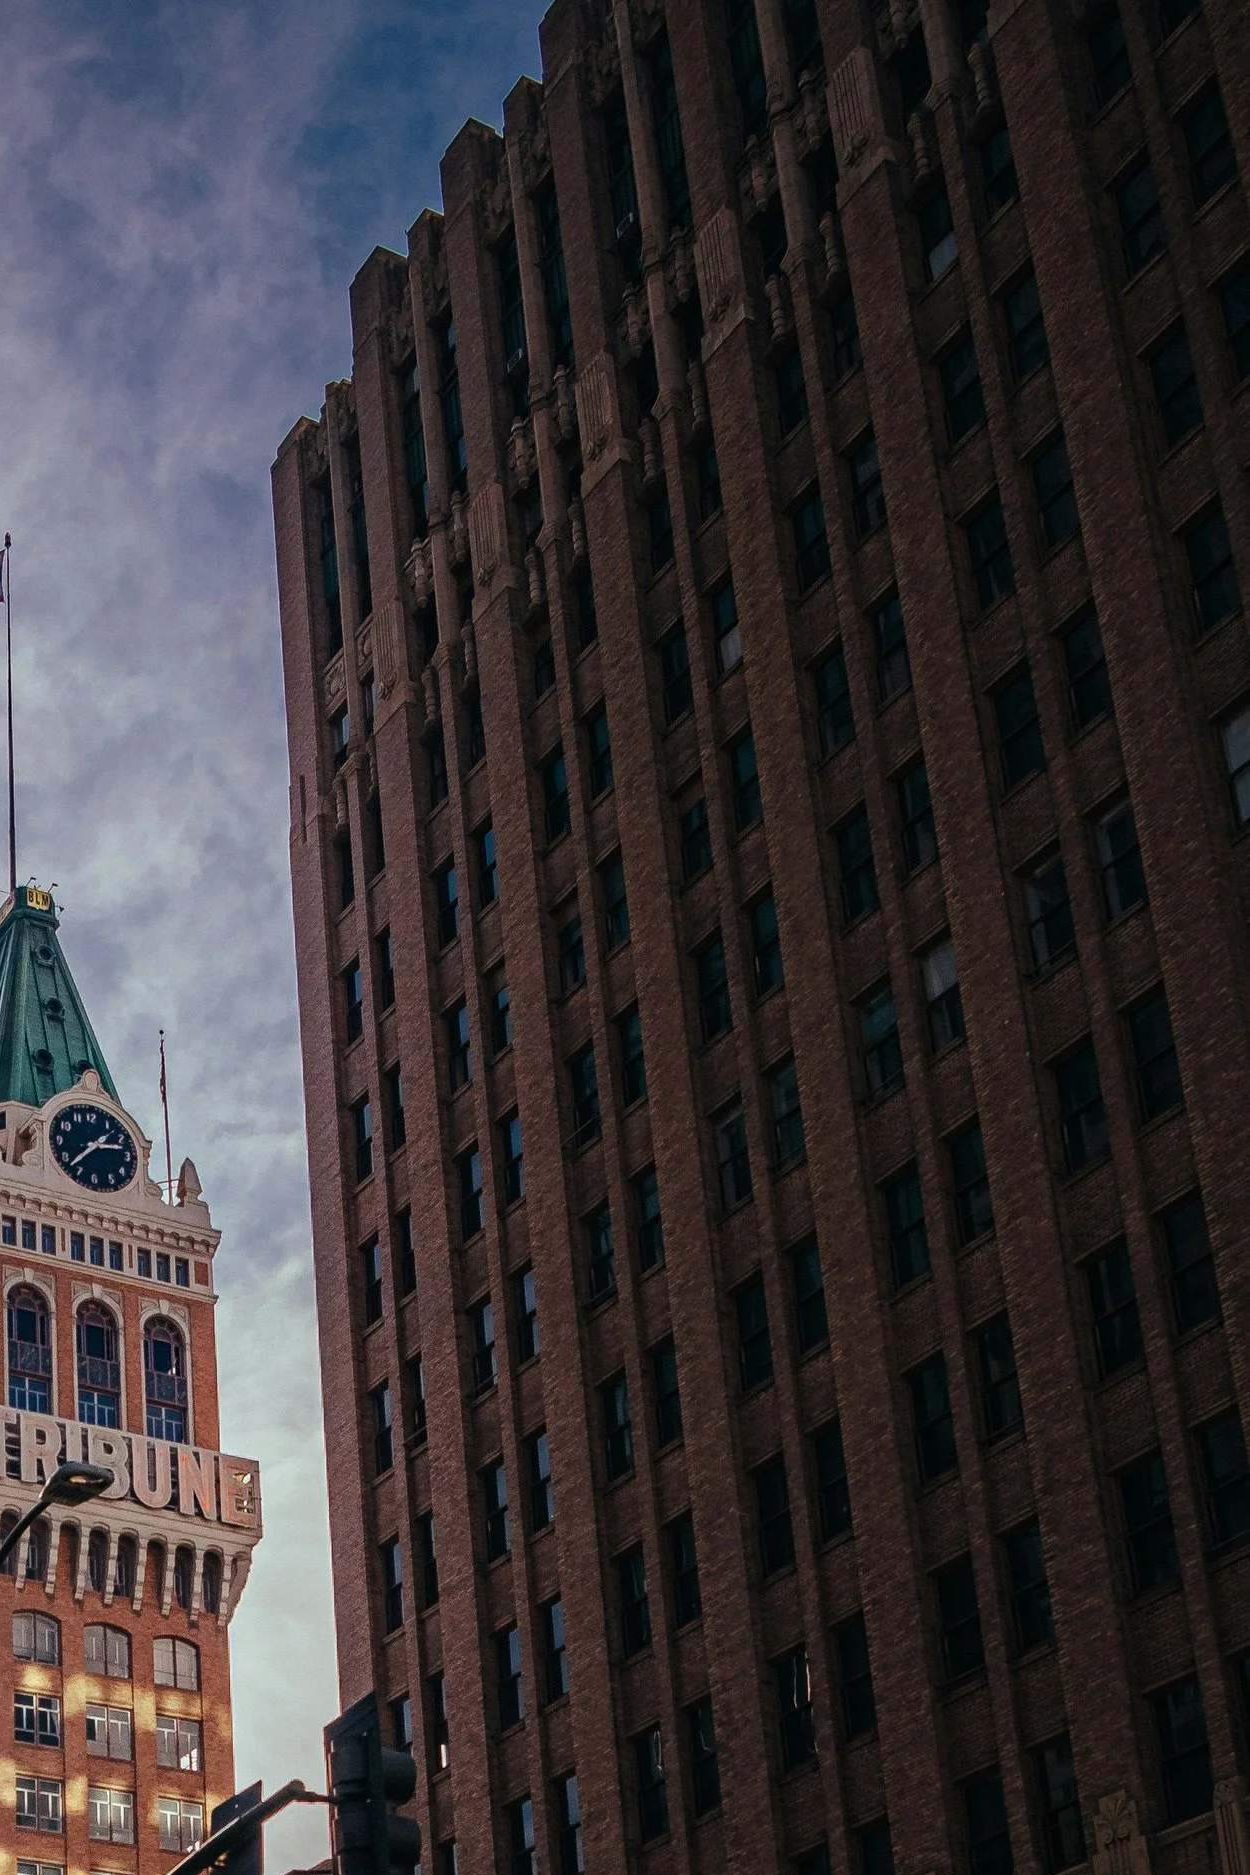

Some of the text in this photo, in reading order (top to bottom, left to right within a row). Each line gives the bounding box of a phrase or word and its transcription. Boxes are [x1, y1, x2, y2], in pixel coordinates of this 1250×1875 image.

[73, 1112, 82, 1123] 11
[86, 1112, 97, 1124] 12
[60, 1120, 72, 1132] 10
[105, 1119, 110, 1130] 1
[56, 1135, 64, 1146] 9
[118, 1133, 125, 1144] 2
[62, 1151, 69, 1162] 8
[124, 1151, 131, 1162] 3
[76, 1166, 83, 1176] 7
[118, 1166, 126, 1176] 4
[90, 1173, 98, 1184] 6
[108, 1173, 115, 1185] 5
